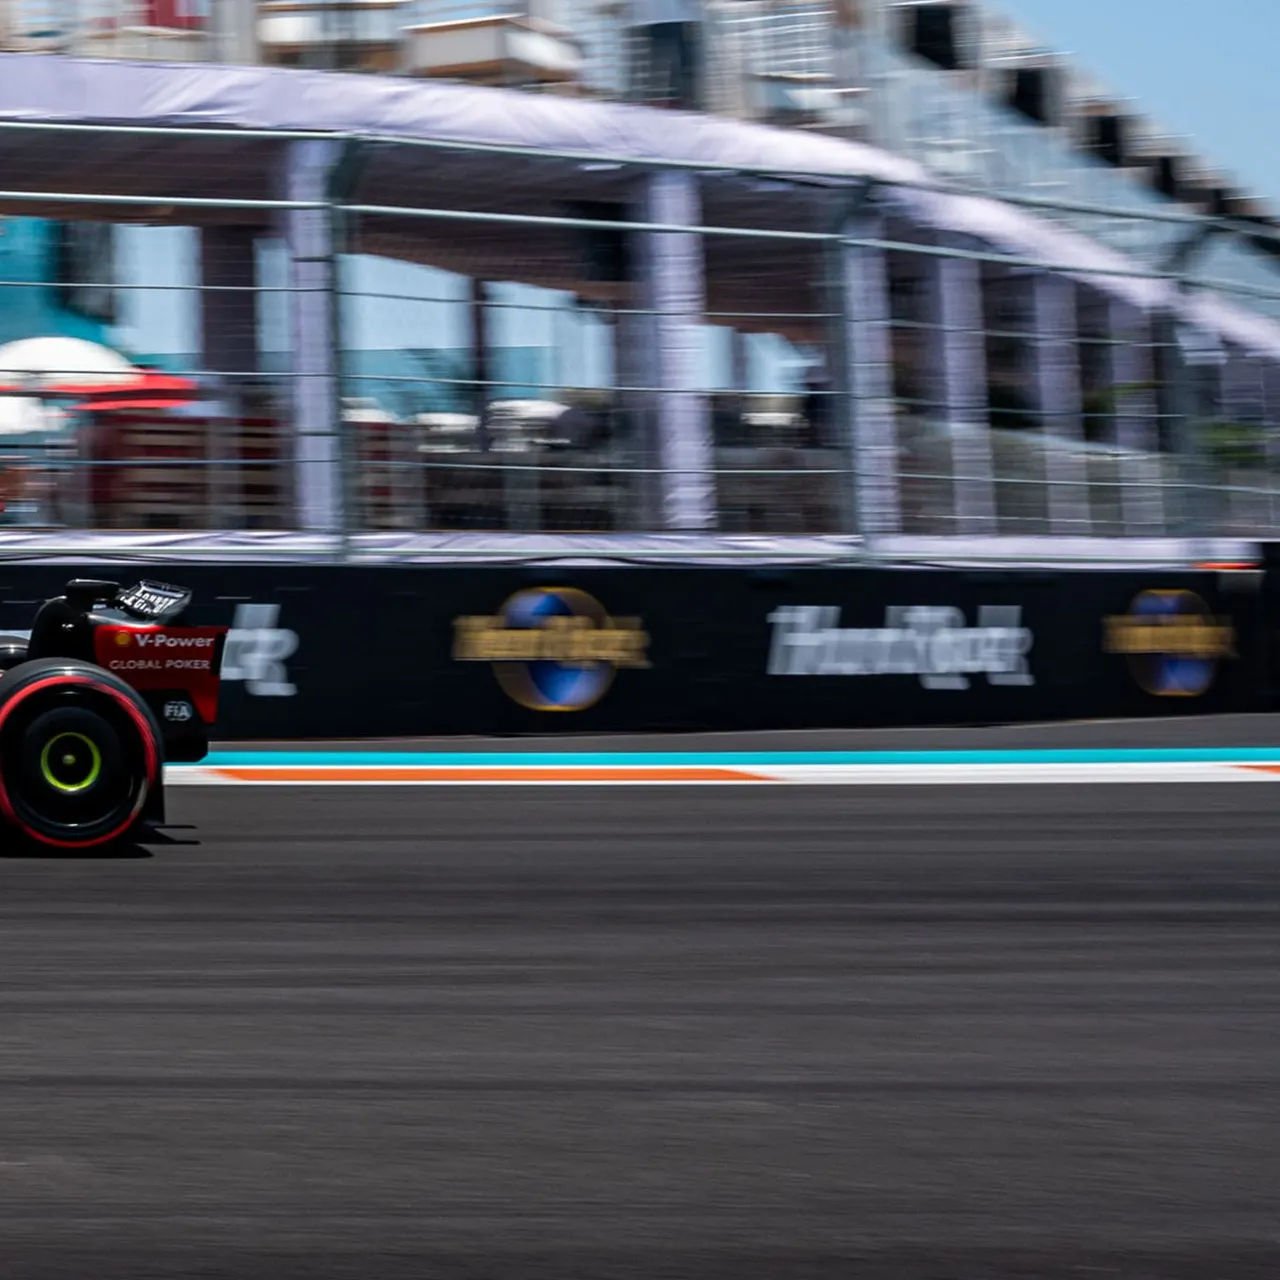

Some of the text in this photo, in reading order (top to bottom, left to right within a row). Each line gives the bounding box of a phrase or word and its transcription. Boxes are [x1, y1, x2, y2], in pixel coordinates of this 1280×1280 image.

[136, 633, 215, 648] V-Power
[109, 659, 211, 670] GLOBAL POKER
